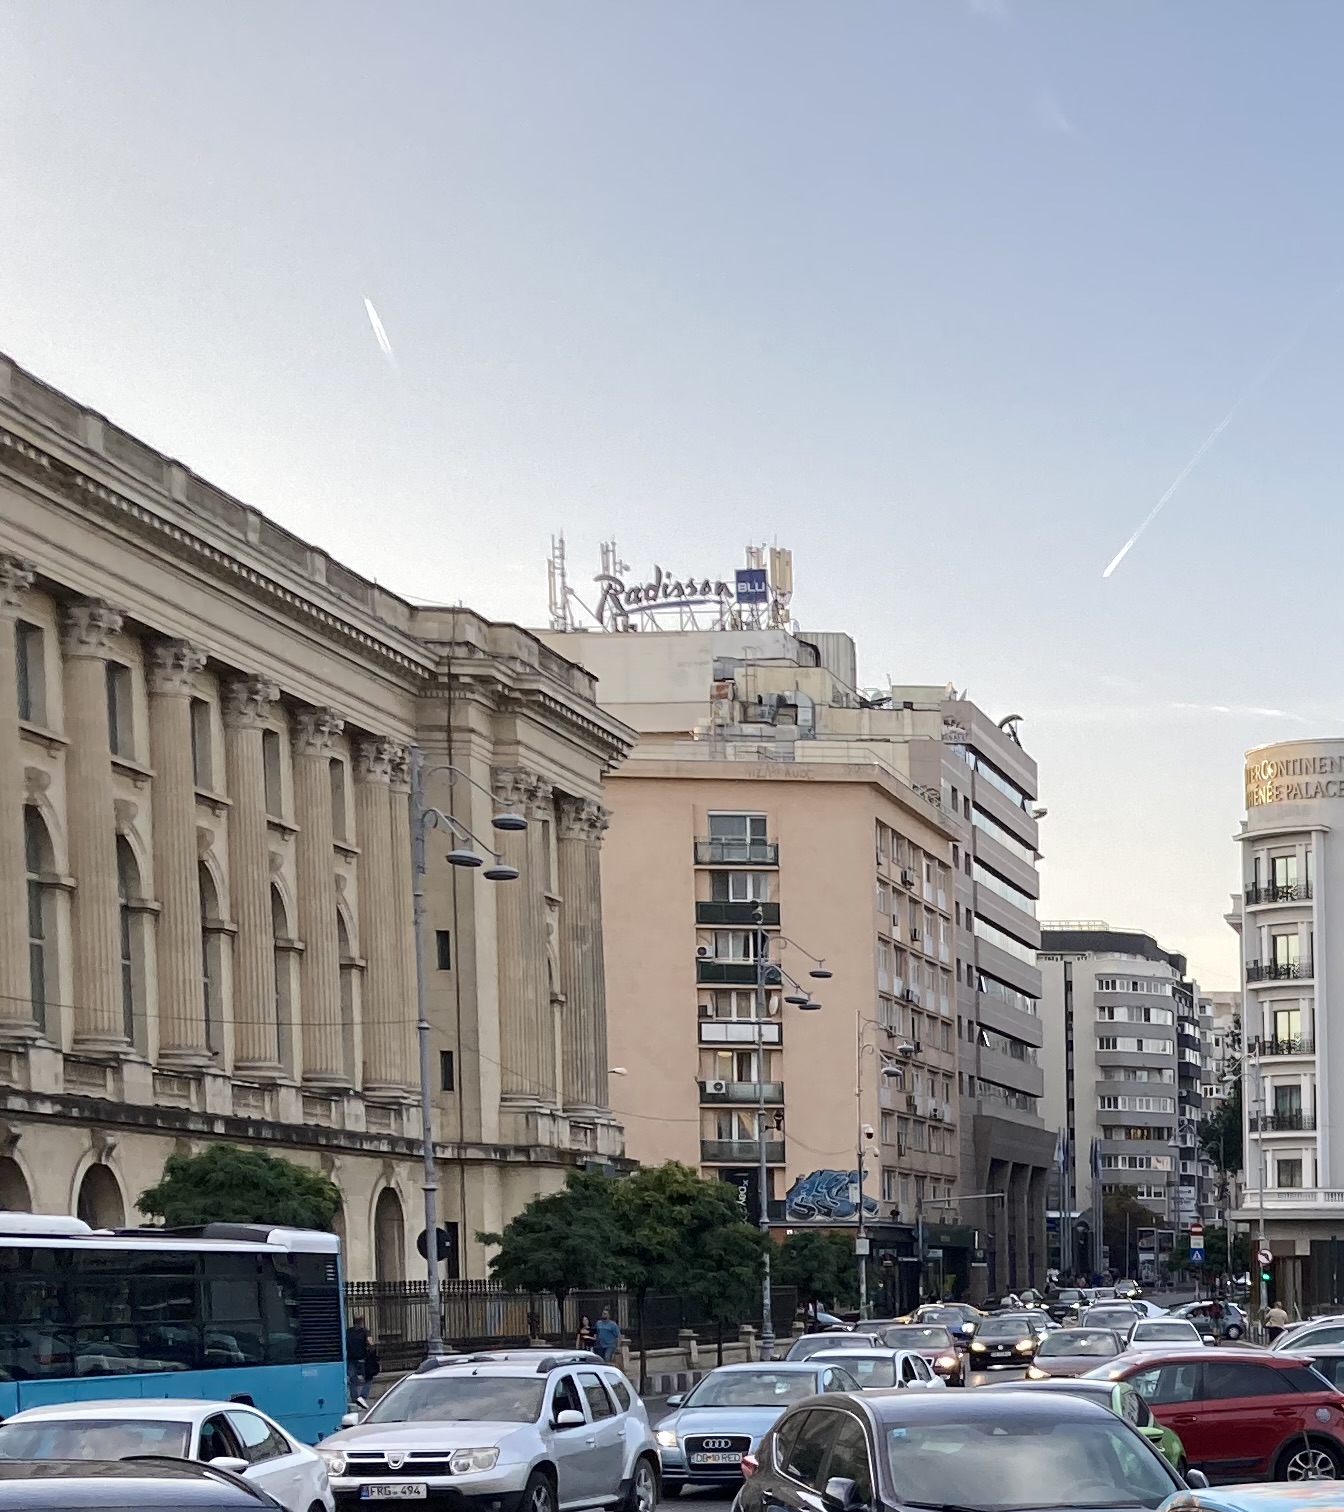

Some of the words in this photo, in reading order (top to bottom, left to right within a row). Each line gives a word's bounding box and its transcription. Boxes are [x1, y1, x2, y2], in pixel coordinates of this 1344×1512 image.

[737, 582, 766, 593] BLU
[593, 564, 734, 625] Radisson
[401, 1485, 421, 1495] 494
